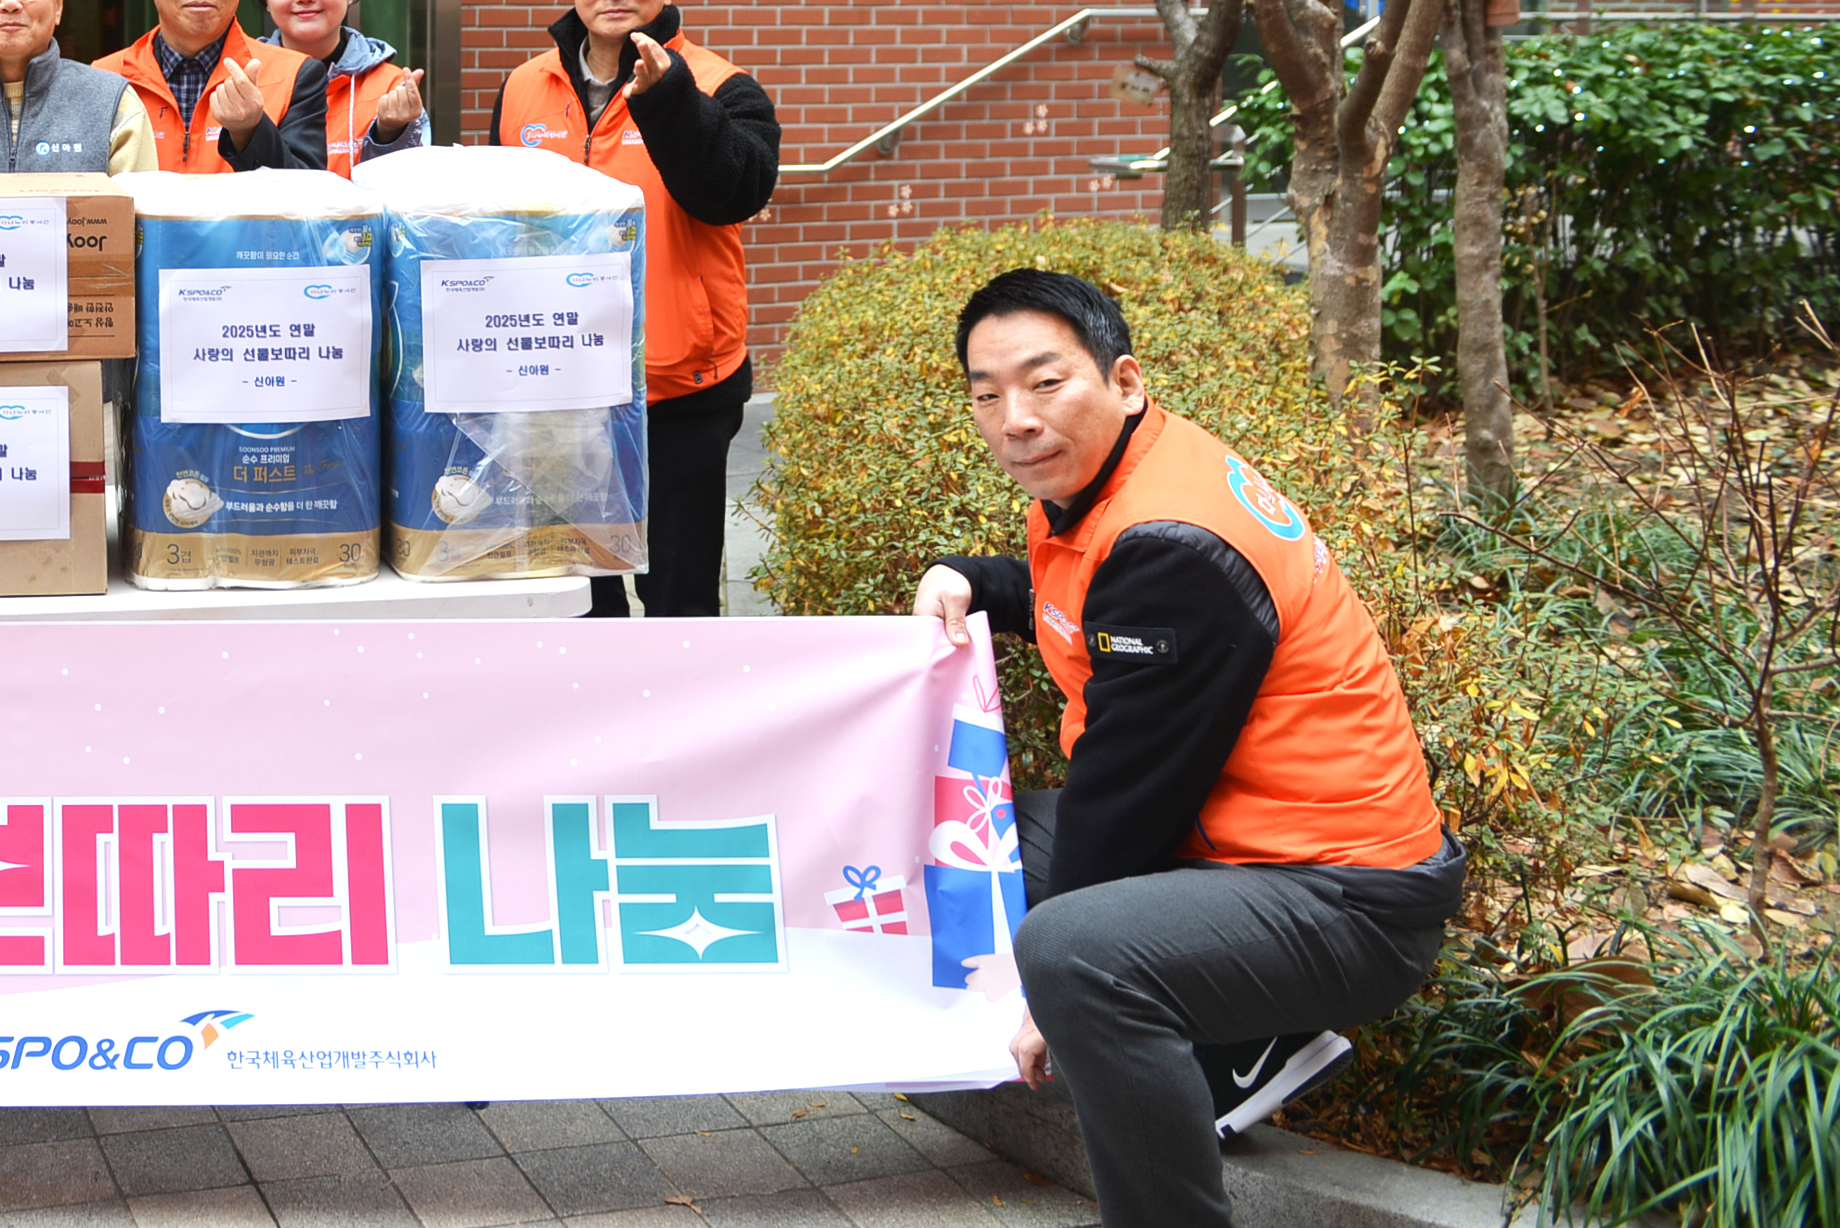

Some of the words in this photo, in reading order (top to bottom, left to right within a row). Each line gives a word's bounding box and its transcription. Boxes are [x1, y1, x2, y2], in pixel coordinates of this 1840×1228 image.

[51, 143, 83, 153] 신아원
[67, 218, 107, 227] www.jooy
[67, 235, 107, 251] Jooy
[236, 251, 264, 260] 깨끗함이
[266, 251, 286, 260] 필요한
[286, 252, 300, 260] 순간
[9, 276, 35, 290] 나눔
[86, 303, 114, 313] 안전한
[95, 317, 114, 327] 항상
[485, 314, 545, 327] 2025년도
[552, 313, 579, 326] 연말
[222, 324, 281, 339] 2025년도
[289, 323, 315, 337] 연말
[457, 338, 497, 352] 사랑의
[507, 336, 574, 350] 선물보따리
[582, 334, 604, 346] 나눔
[193, 348, 233, 361] 사랑의
[243, 347, 310, 361] 선물보따리
[318, 346, 343, 359] 나눔
[518, 365, 549, 376] 신아원
[254, 377, 285, 387] 신아원
[242, 455, 258, 464] 순수
[260, 455, 290, 463] 프리미엄
[11, 467, 37, 481] 나눔
[234, 467, 247, 483] 더
[254, 465, 297, 483] 퍼스트
[225, 501, 264, 513] 부드러움과
[265, 501, 294, 512] 순수함을
[296, 501, 303, 510] 더
[305, 501, 313, 510] 한
[314, 500, 337, 510] 깨끗함
[397, 539, 411, 556] 30
[610, 534, 632, 553] 30
[167, 543, 192, 565] 3겹
[251, 549, 279, 557] 지관까지
[289, 548, 316, 556] 피부자극
[339, 543, 362, 563] 30
[1110, 636, 1143, 645] NATIONAL
[1111, 644, 1154, 654] GEOGRAPHIC
[434, 795, 786, 974] 나눔
[226, 1049, 436, 1071] 한국체육산업개발주식회사
